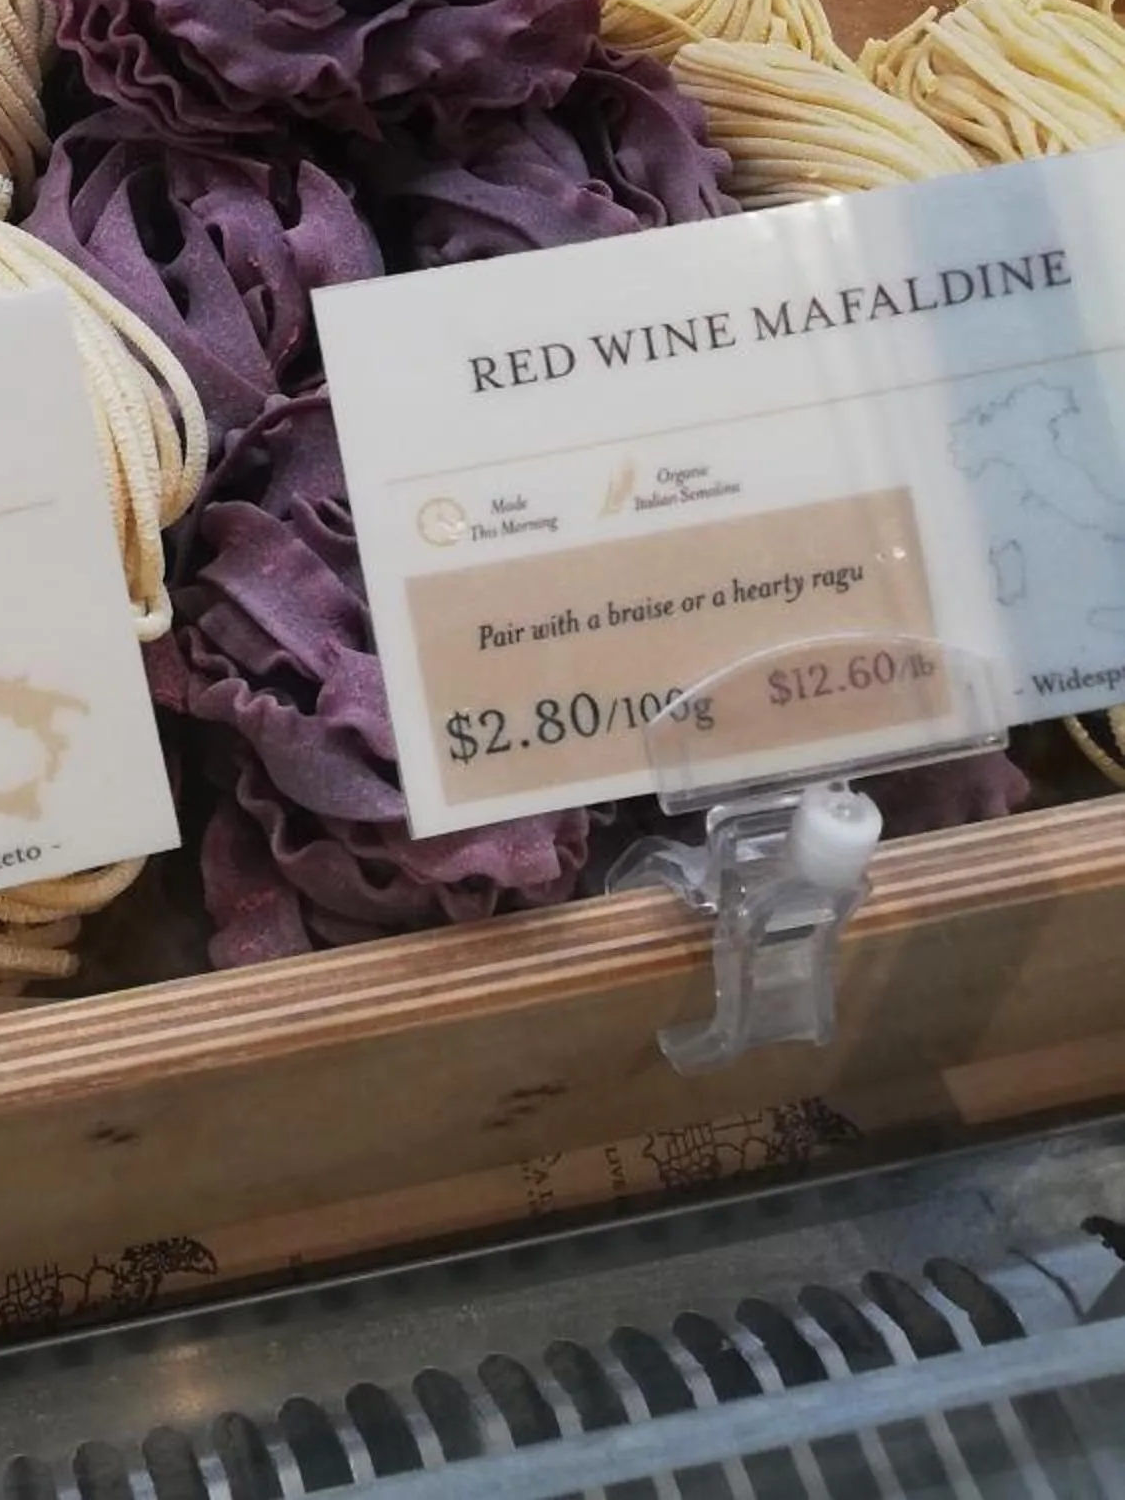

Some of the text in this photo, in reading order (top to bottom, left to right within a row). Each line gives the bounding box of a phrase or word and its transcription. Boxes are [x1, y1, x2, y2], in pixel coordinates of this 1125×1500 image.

[467, 249, 1072, 393] RED WINE MAFALDINE
[490, 493, 529, 516] Made
[634, 480, 741, 513] Italian Semolina
[470, 515, 559, 542] This Morning
[478, 564, 864, 651] Pair with a braise or a hearty ragu
[767, 648, 936, 708] $12.60/lb
[445, 686, 715, 766] $2.80/100g
